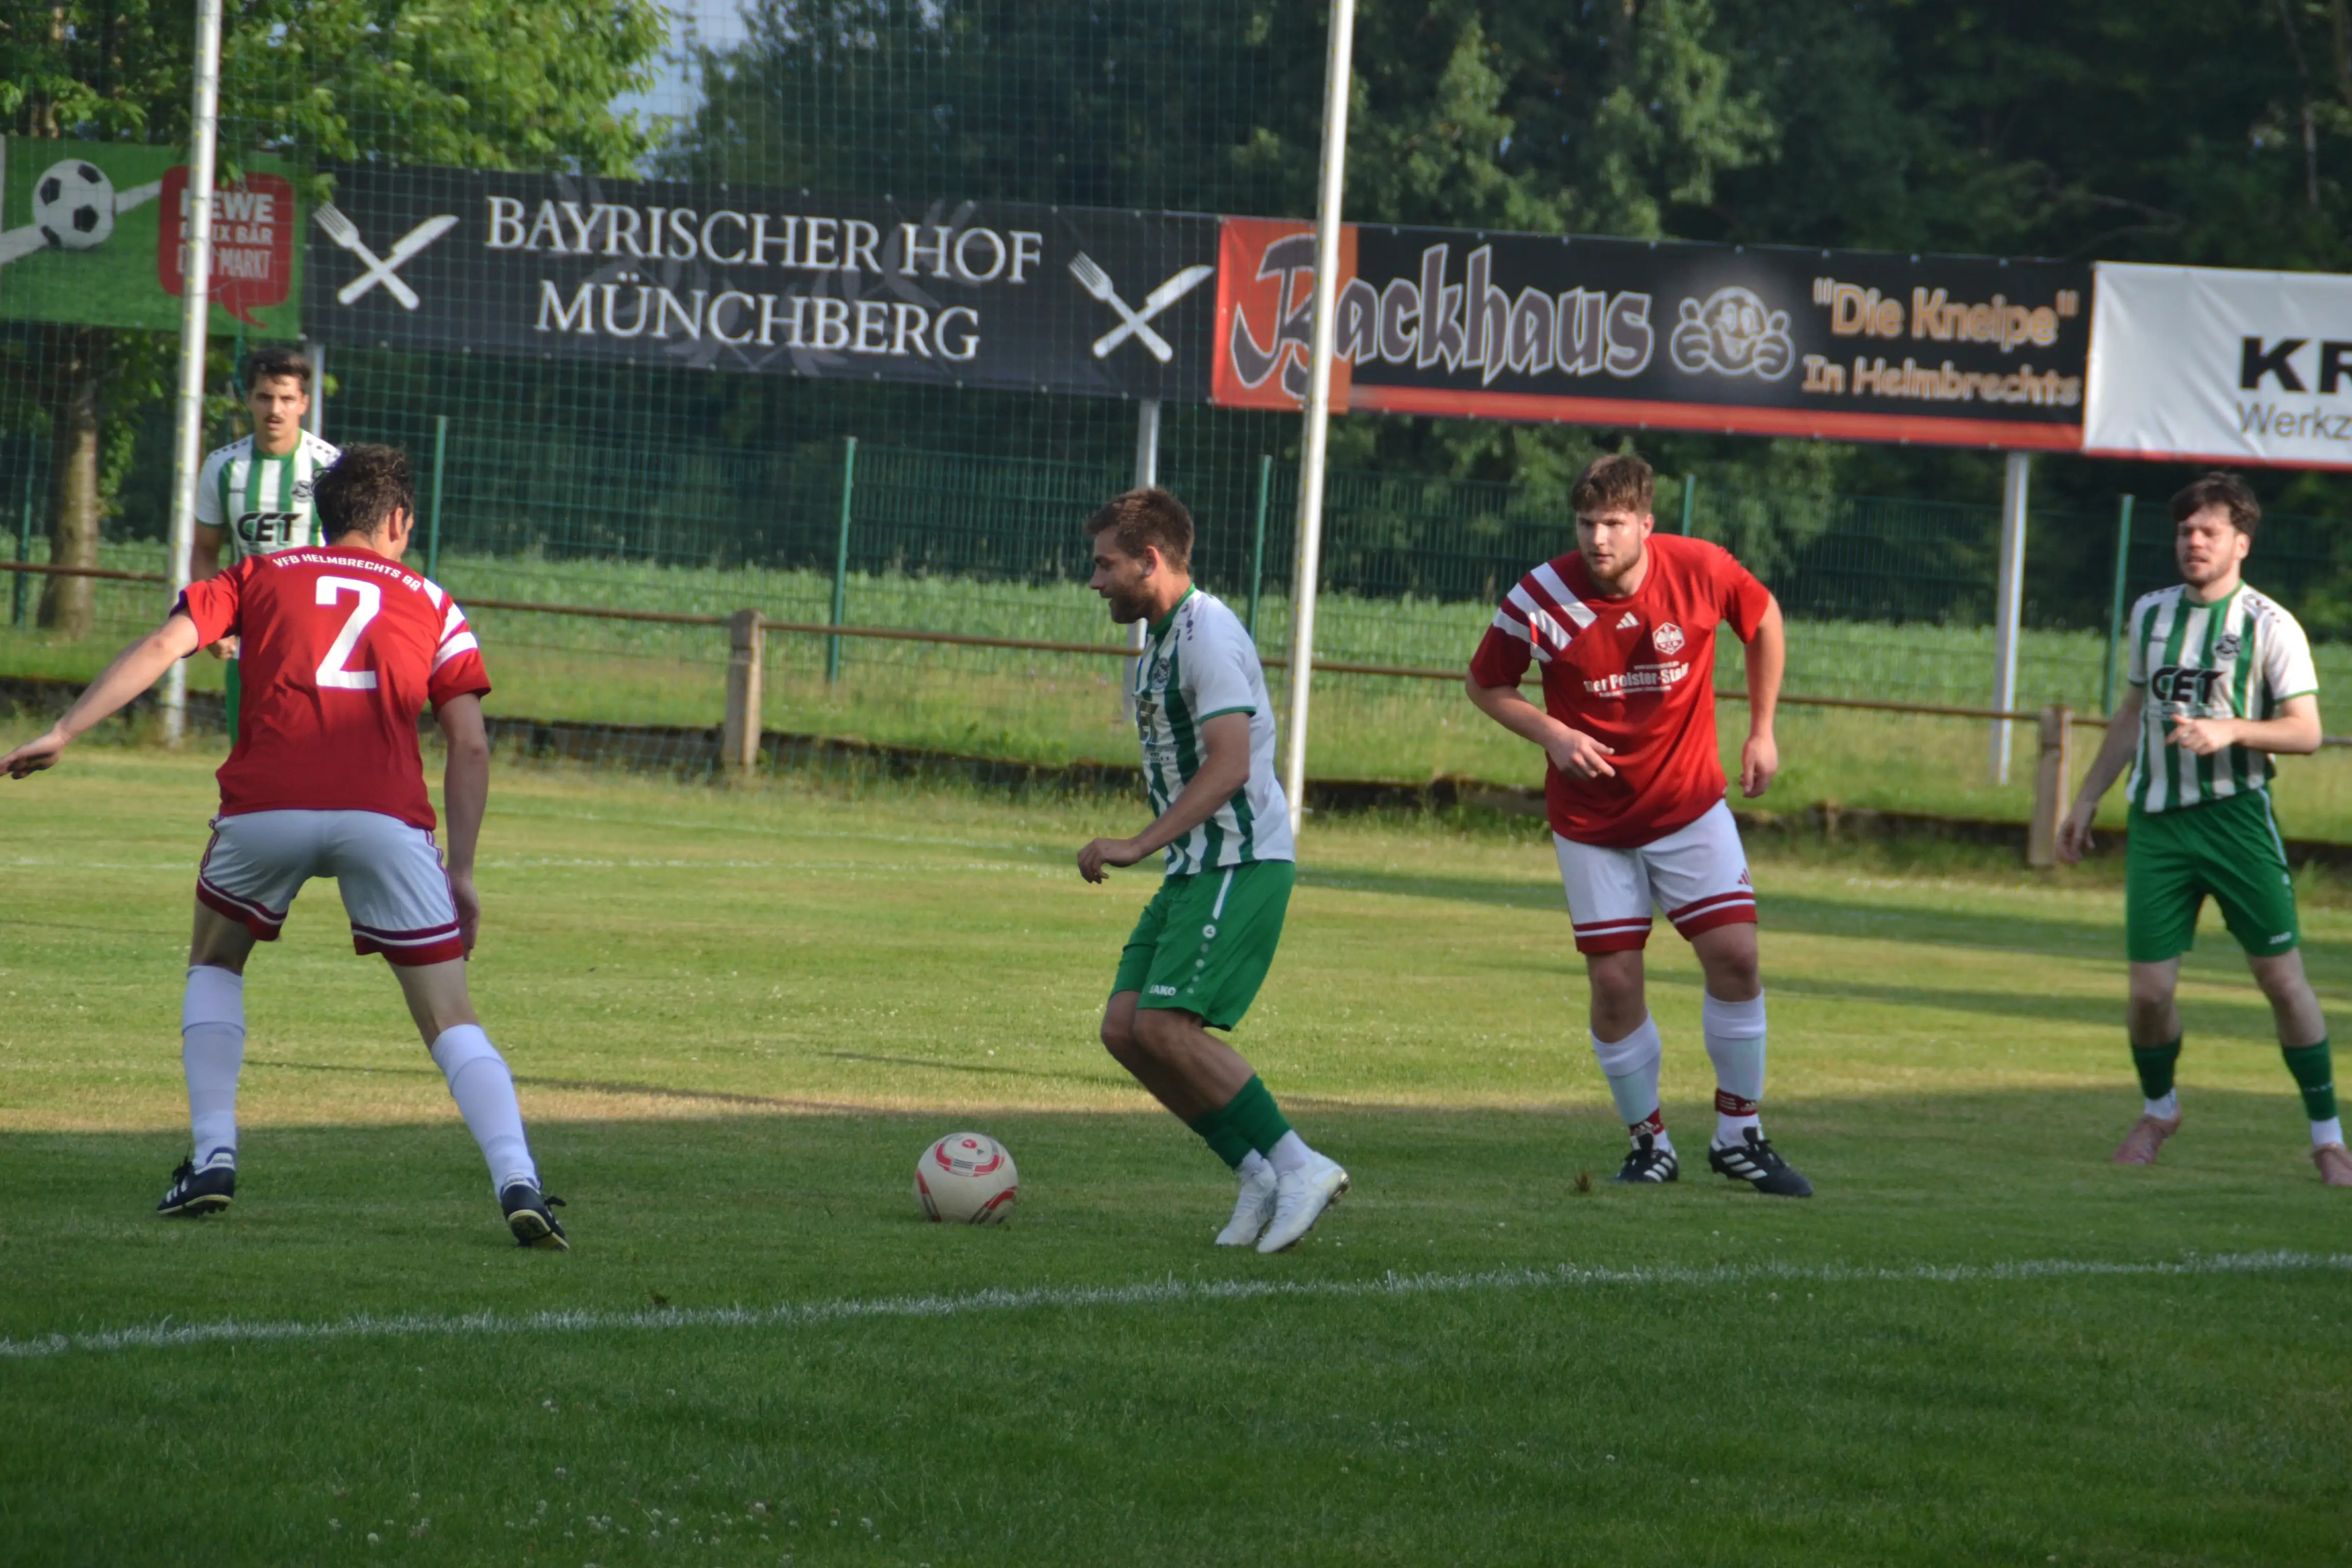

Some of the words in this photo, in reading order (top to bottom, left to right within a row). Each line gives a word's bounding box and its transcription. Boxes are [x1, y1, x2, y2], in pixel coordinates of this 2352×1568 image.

[485, 195, 885, 274] BAYRISCHER
[898, 223, 1043, 284] HOF
[533, 271, 980, 361] MÜNCHBERG
[1813, 277, 1904, 339] "Die
[1911, 286, 2080, 353] Kneipe"
[1802, 354, 1846, 394] In
[1852, 356, 2081, 405] Helmbrechts
[272, 554, 301, 568] VFB
[301, 553, 402, 579] HELMBRECHTS
[315, 575, 381, 689] 2
[2152, 666, 2226, 704] CET
